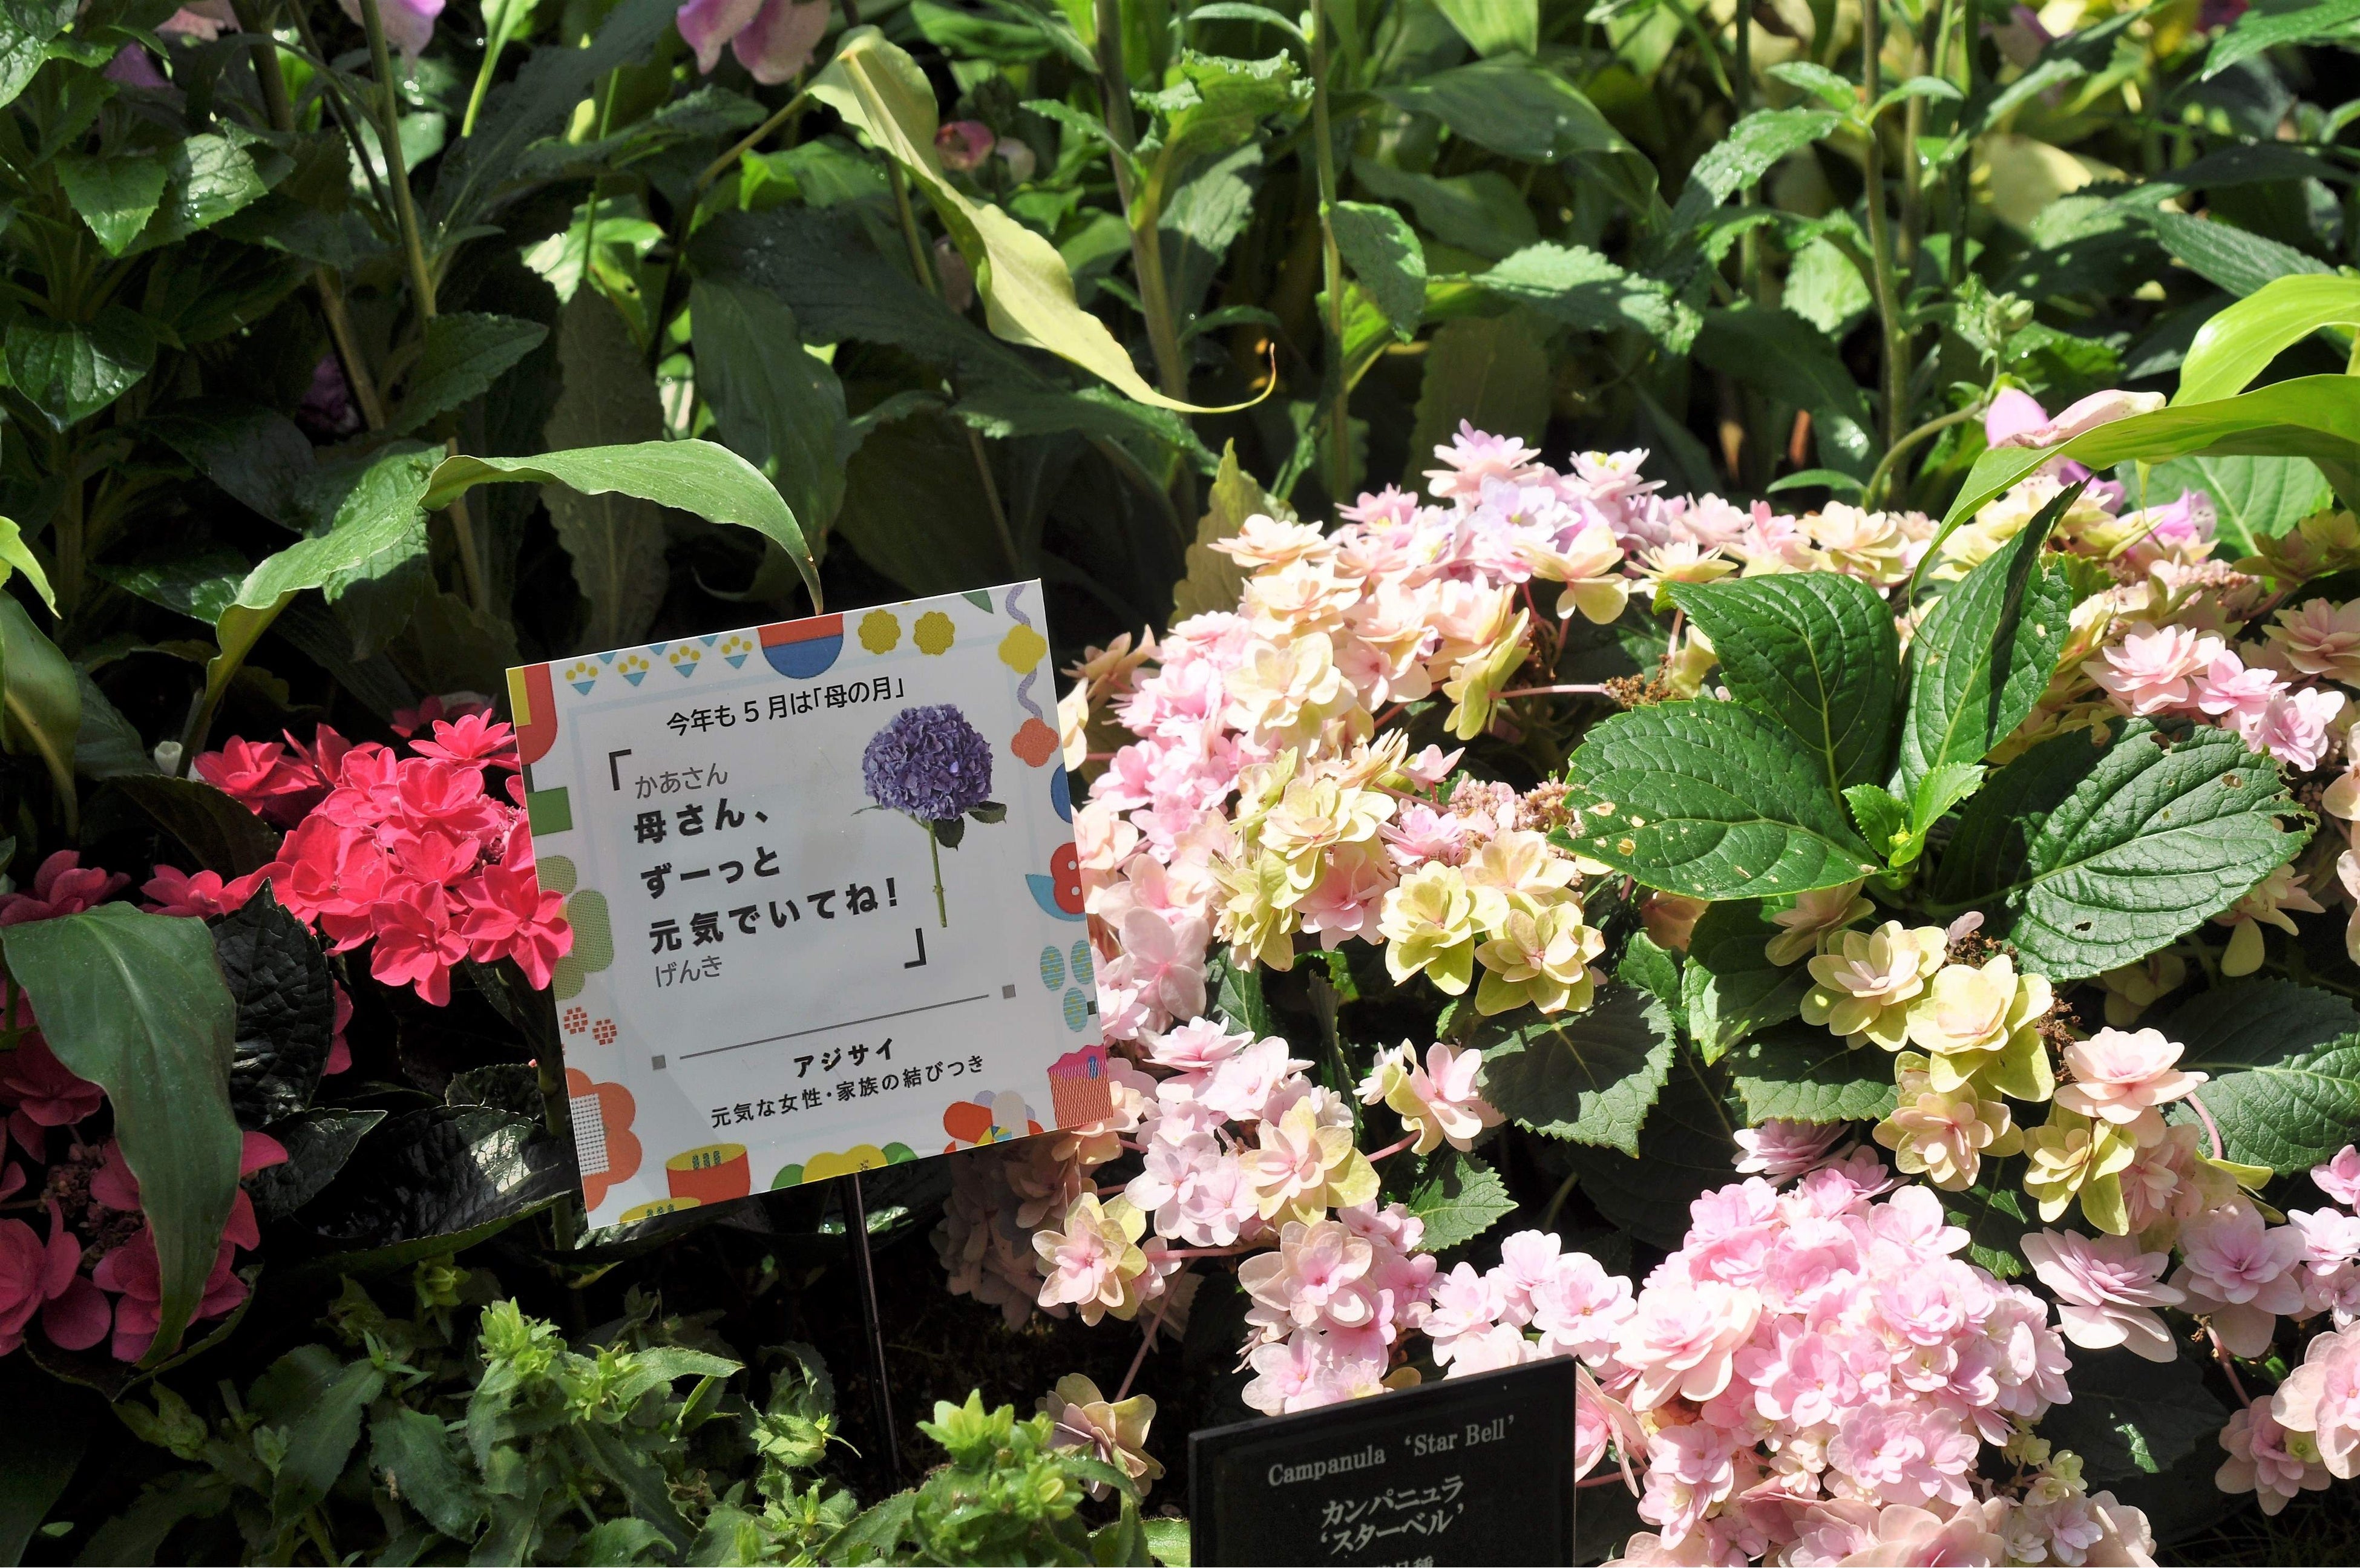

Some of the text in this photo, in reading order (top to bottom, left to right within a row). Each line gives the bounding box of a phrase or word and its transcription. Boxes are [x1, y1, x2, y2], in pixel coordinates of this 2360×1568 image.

[635, 763, 728, 799] かあさん
[640, 846, 781, 899] ずーっと
[655, 956, 723, 988] げんき
[793, 1038, 893, 1078] アジサイ
[1268, 1445, 1386, 1486] Campanula
[1322, 1475, 1464, 1529] カンパニュラ
